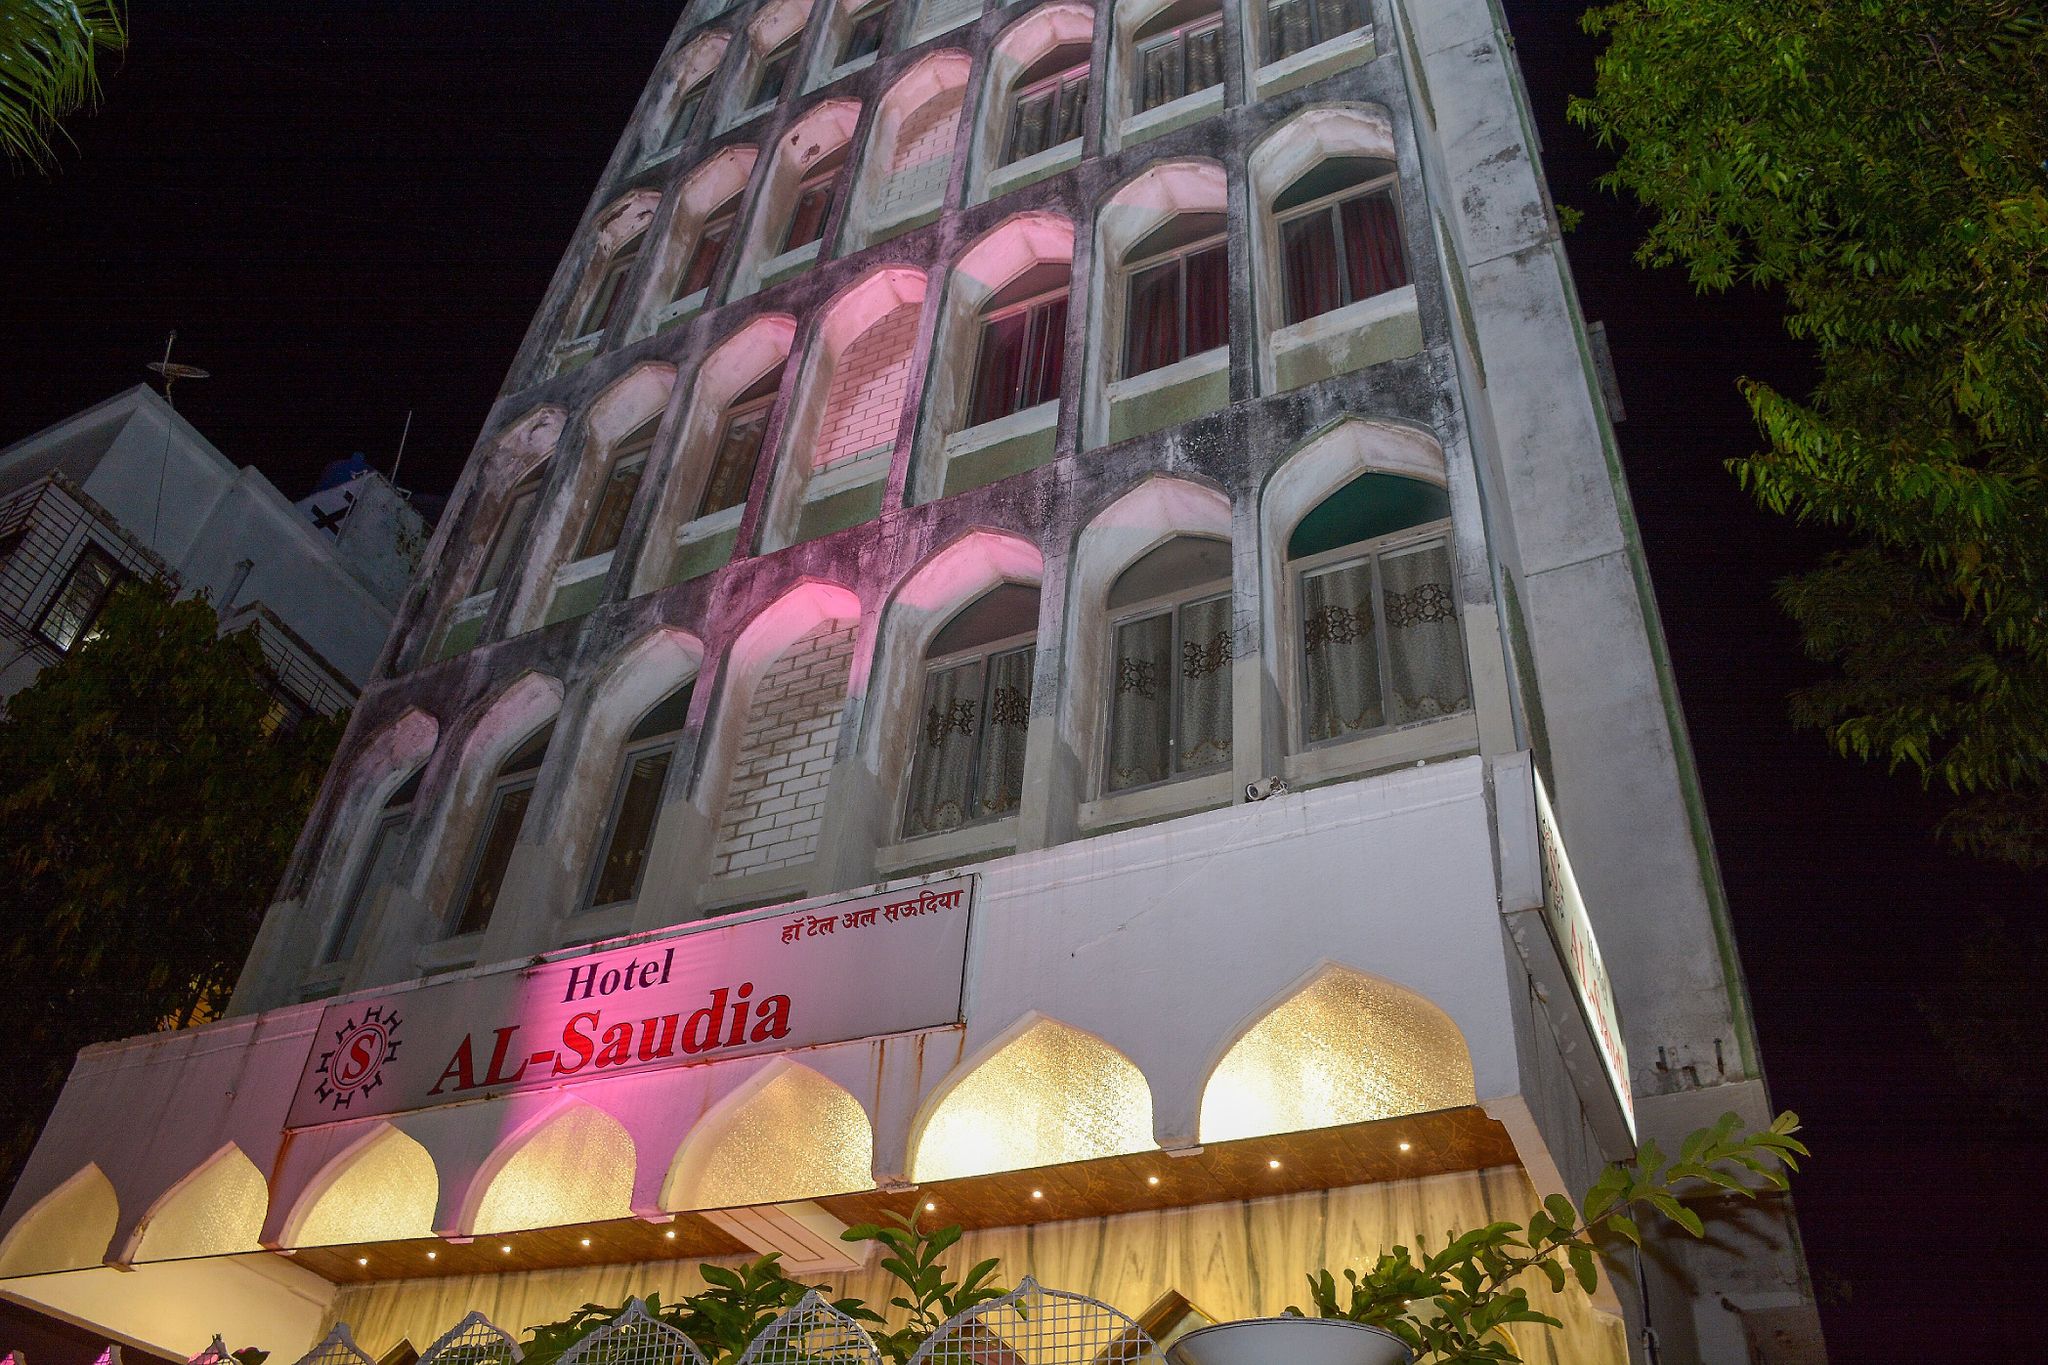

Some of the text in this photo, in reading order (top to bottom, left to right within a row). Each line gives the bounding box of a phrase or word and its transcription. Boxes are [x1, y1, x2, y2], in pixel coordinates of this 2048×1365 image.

[842, 907, 880, 929] अल
[883, 889, 965, 923] सऊदिया
[562, 948, 675, 1003] Hotel
[341, 1033, 377, 1080] S
[427, 982, 793, 1097] AL-Saudia
